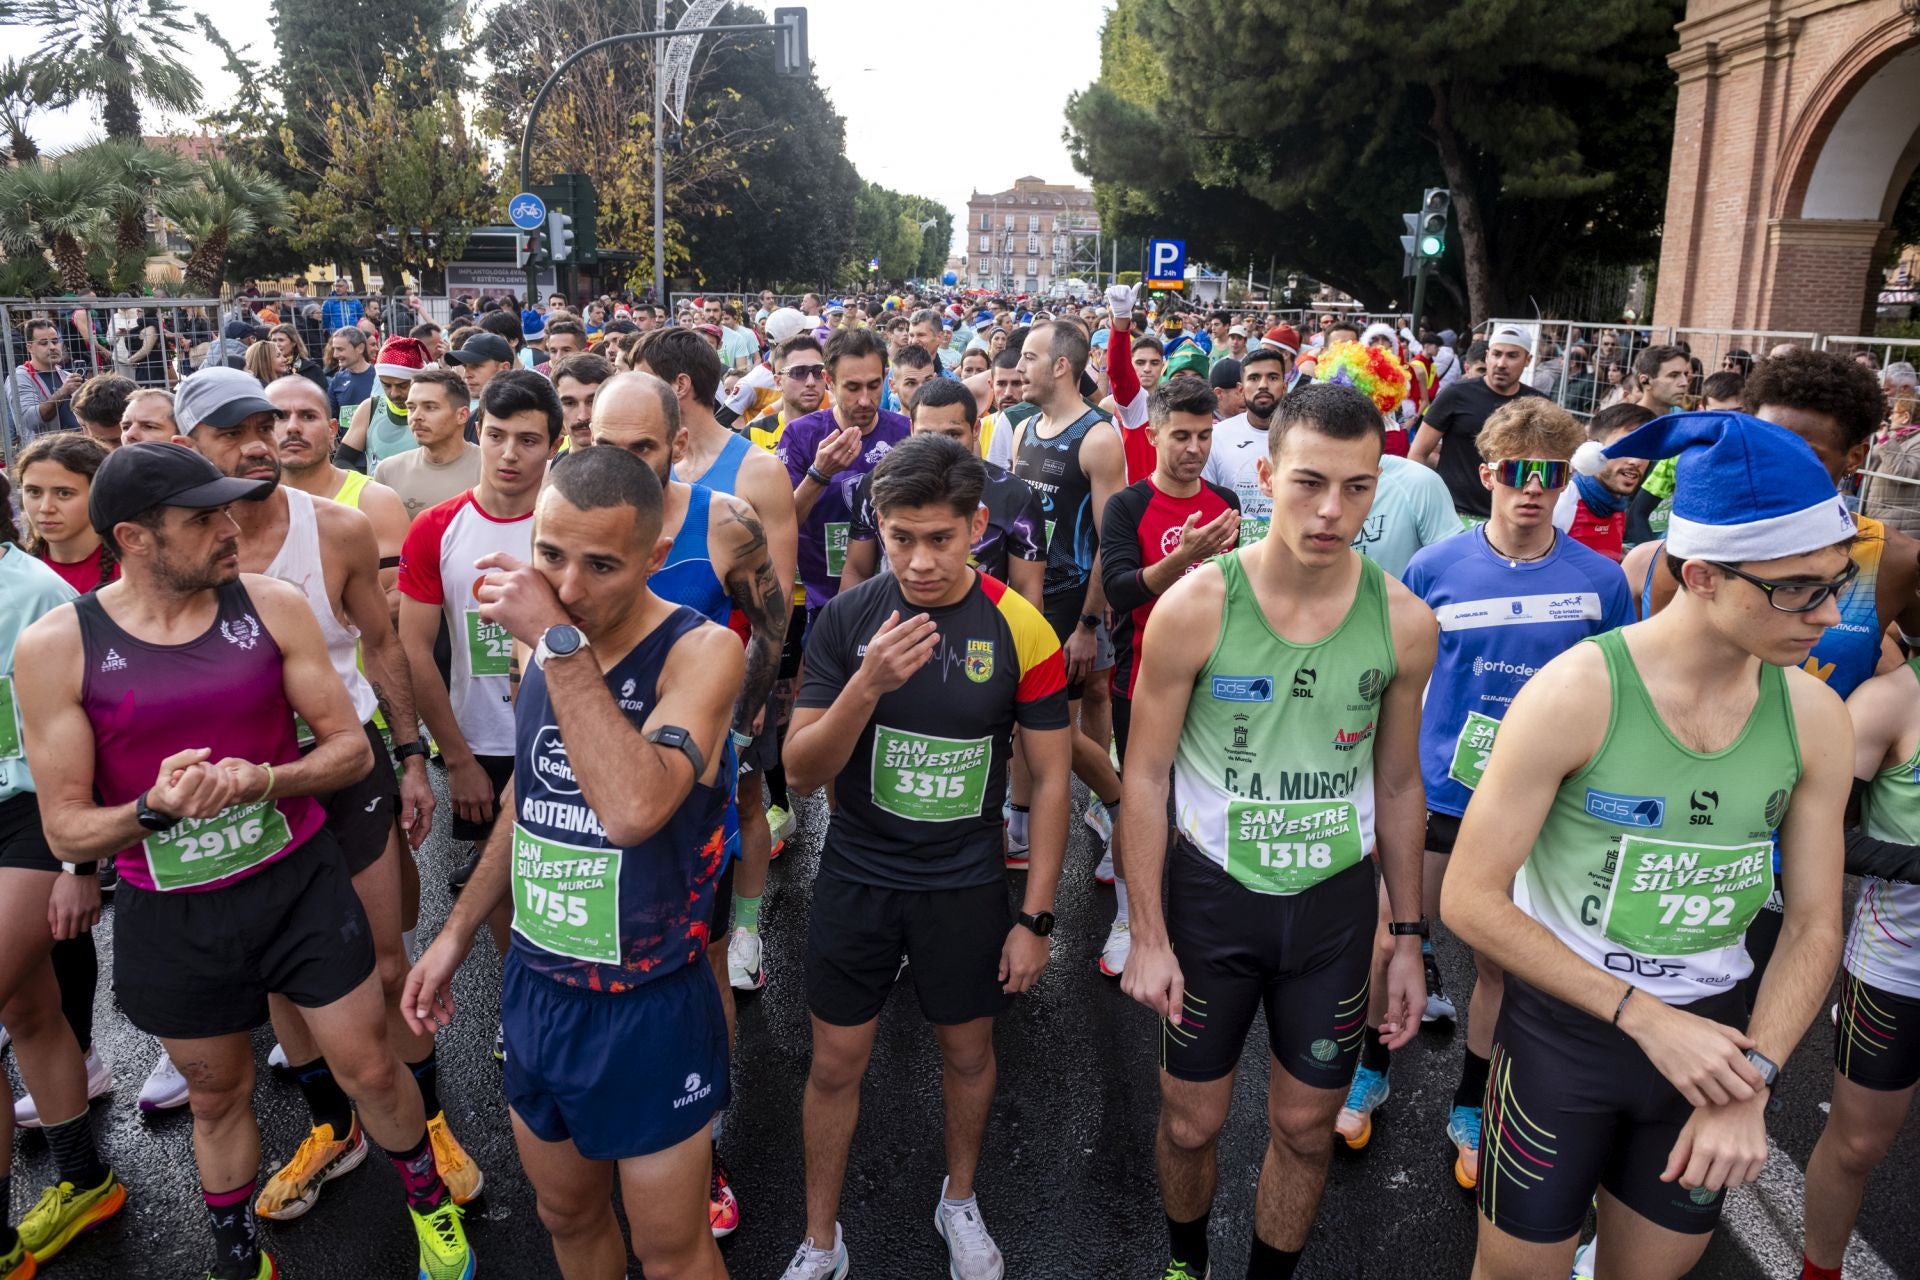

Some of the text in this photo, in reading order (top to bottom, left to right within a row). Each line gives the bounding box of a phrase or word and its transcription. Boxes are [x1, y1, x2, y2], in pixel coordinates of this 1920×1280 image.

[1154, 243, 1179, 276] P
[833, 528, 848, 539] SA
[477, 627, 508, 641] SILV
[485, 640, 512, 657] 25
[968, 640, 992, 651] LEVEL
[101, 658, 127, 669] AIRE
[1292, 688, 1314, 698] SDL
[616, 699, 644, 712] ATOR
[1473, 724, 1495, 739] SA
[887, 739, 928, 755] SAN
[1468, 736, 1493, 750] SIL
[884, 744, 985, 768] SILVESTRE
[943, 759, 982, 775] MURCIA
[895, 769, 966, 798] 3315
[1238, 805, 1350, 841] SILVESTRE
[1240, 808, 1286, 825] SAN
[1689, 815, 1714, 825] SDL
[175, 818, 264, 863] 2916
[1305, 824, 1350, 841] MURCIA
[518, 840, 542, 862] SAN
[1256, 842, 1332, 869] 1318
[517, 857, 609, 880] SILVESTRE
[1636, 852, 1701, 872] SAN
[1630, 850, 1766, 892] SILVESTRE
[558, 878, 604, 891] MURCIA
[1713, 875, 1763, 894] MURCIA
[524, 878, 588, 927] 1755
[1658, 895, 1736, 927] 792
[1691, 973, 1731, 983] ROUP
